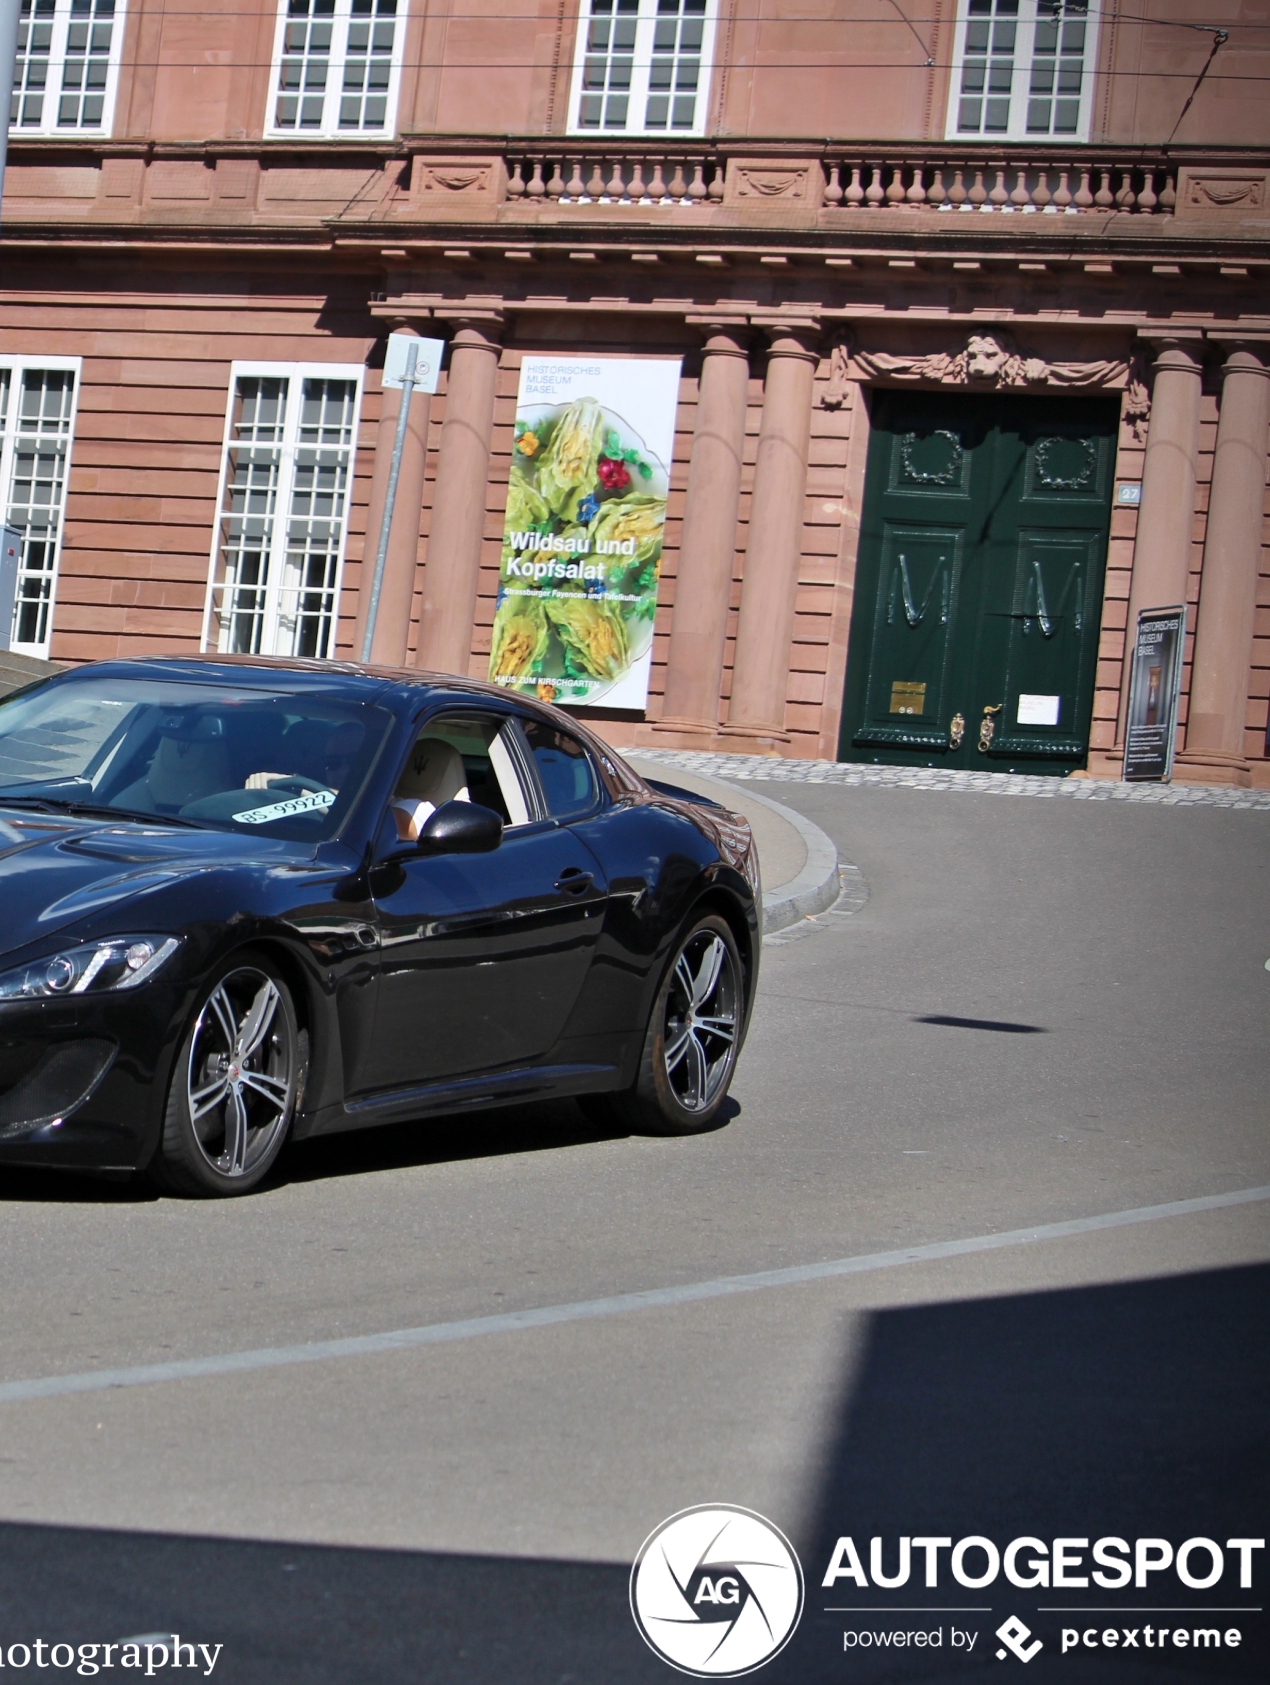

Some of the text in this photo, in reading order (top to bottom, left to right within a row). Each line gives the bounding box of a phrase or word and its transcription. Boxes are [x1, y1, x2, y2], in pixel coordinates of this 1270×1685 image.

[527, 365, 601, 375] HISTORISCHES
[526, 375, 572, 385] MUSEUM
[525, 385, 557, 394] BASEL
[1122, 488, 1139, 499] 27
[510, 531, 636, 555] Wildsau und
[506, 557, 605, 581] Kopfsalat
[503, 587, 642, 602] Strassburger Fayencen und Tafelkultur
[1140, 620, 1179, 632] HISTORISCHES
[1139, 633, 1163, 644] MUSEUM
[1138, 645, 1155, 656] BASEL
[494, 675, 601, 688] HAUS ZUM KIRSCHGARTEN
[274, 794, 332, 813] 99922
